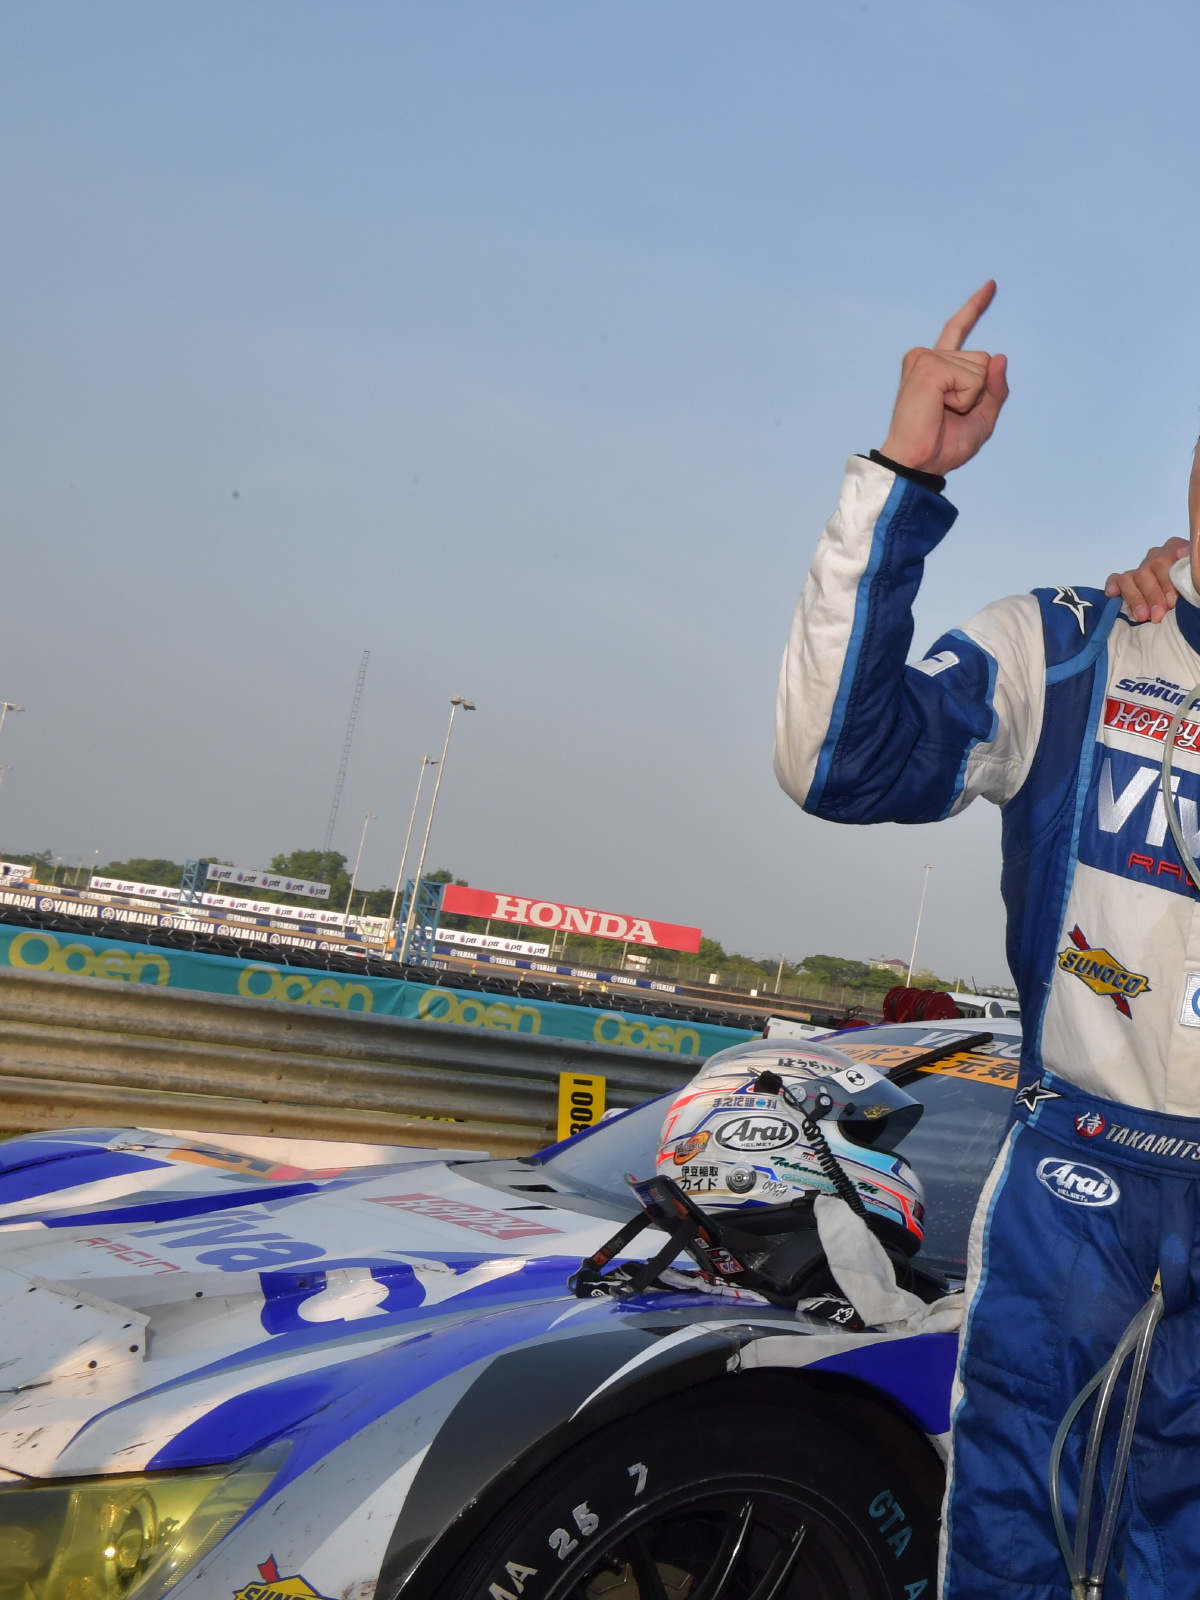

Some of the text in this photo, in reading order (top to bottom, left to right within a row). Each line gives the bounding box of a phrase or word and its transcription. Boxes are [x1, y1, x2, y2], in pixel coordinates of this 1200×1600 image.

[0, 892, 36, 909] MAHA
[54, 900, 98, 918] YAMAHA
[115, 909, 158, 926] YAMAHA
[173, 918, 215, 934] YAMAHA
[230, 927, 268, 943] YAMAHA
[491, 895, 658, 945] HONDA
[1062, 951, 1141, 996] SUNOCO
[721, 1119, 792, 1142] Arai
[1077, 1111, 1103, 1135] 侍
[1040, 1162, 1112, 1199] Arai
[75, 1236, 189, 1275] RACIN
[549, 1500, 600, 1561] 25
[868, 1489, 913, 1560] GTA
